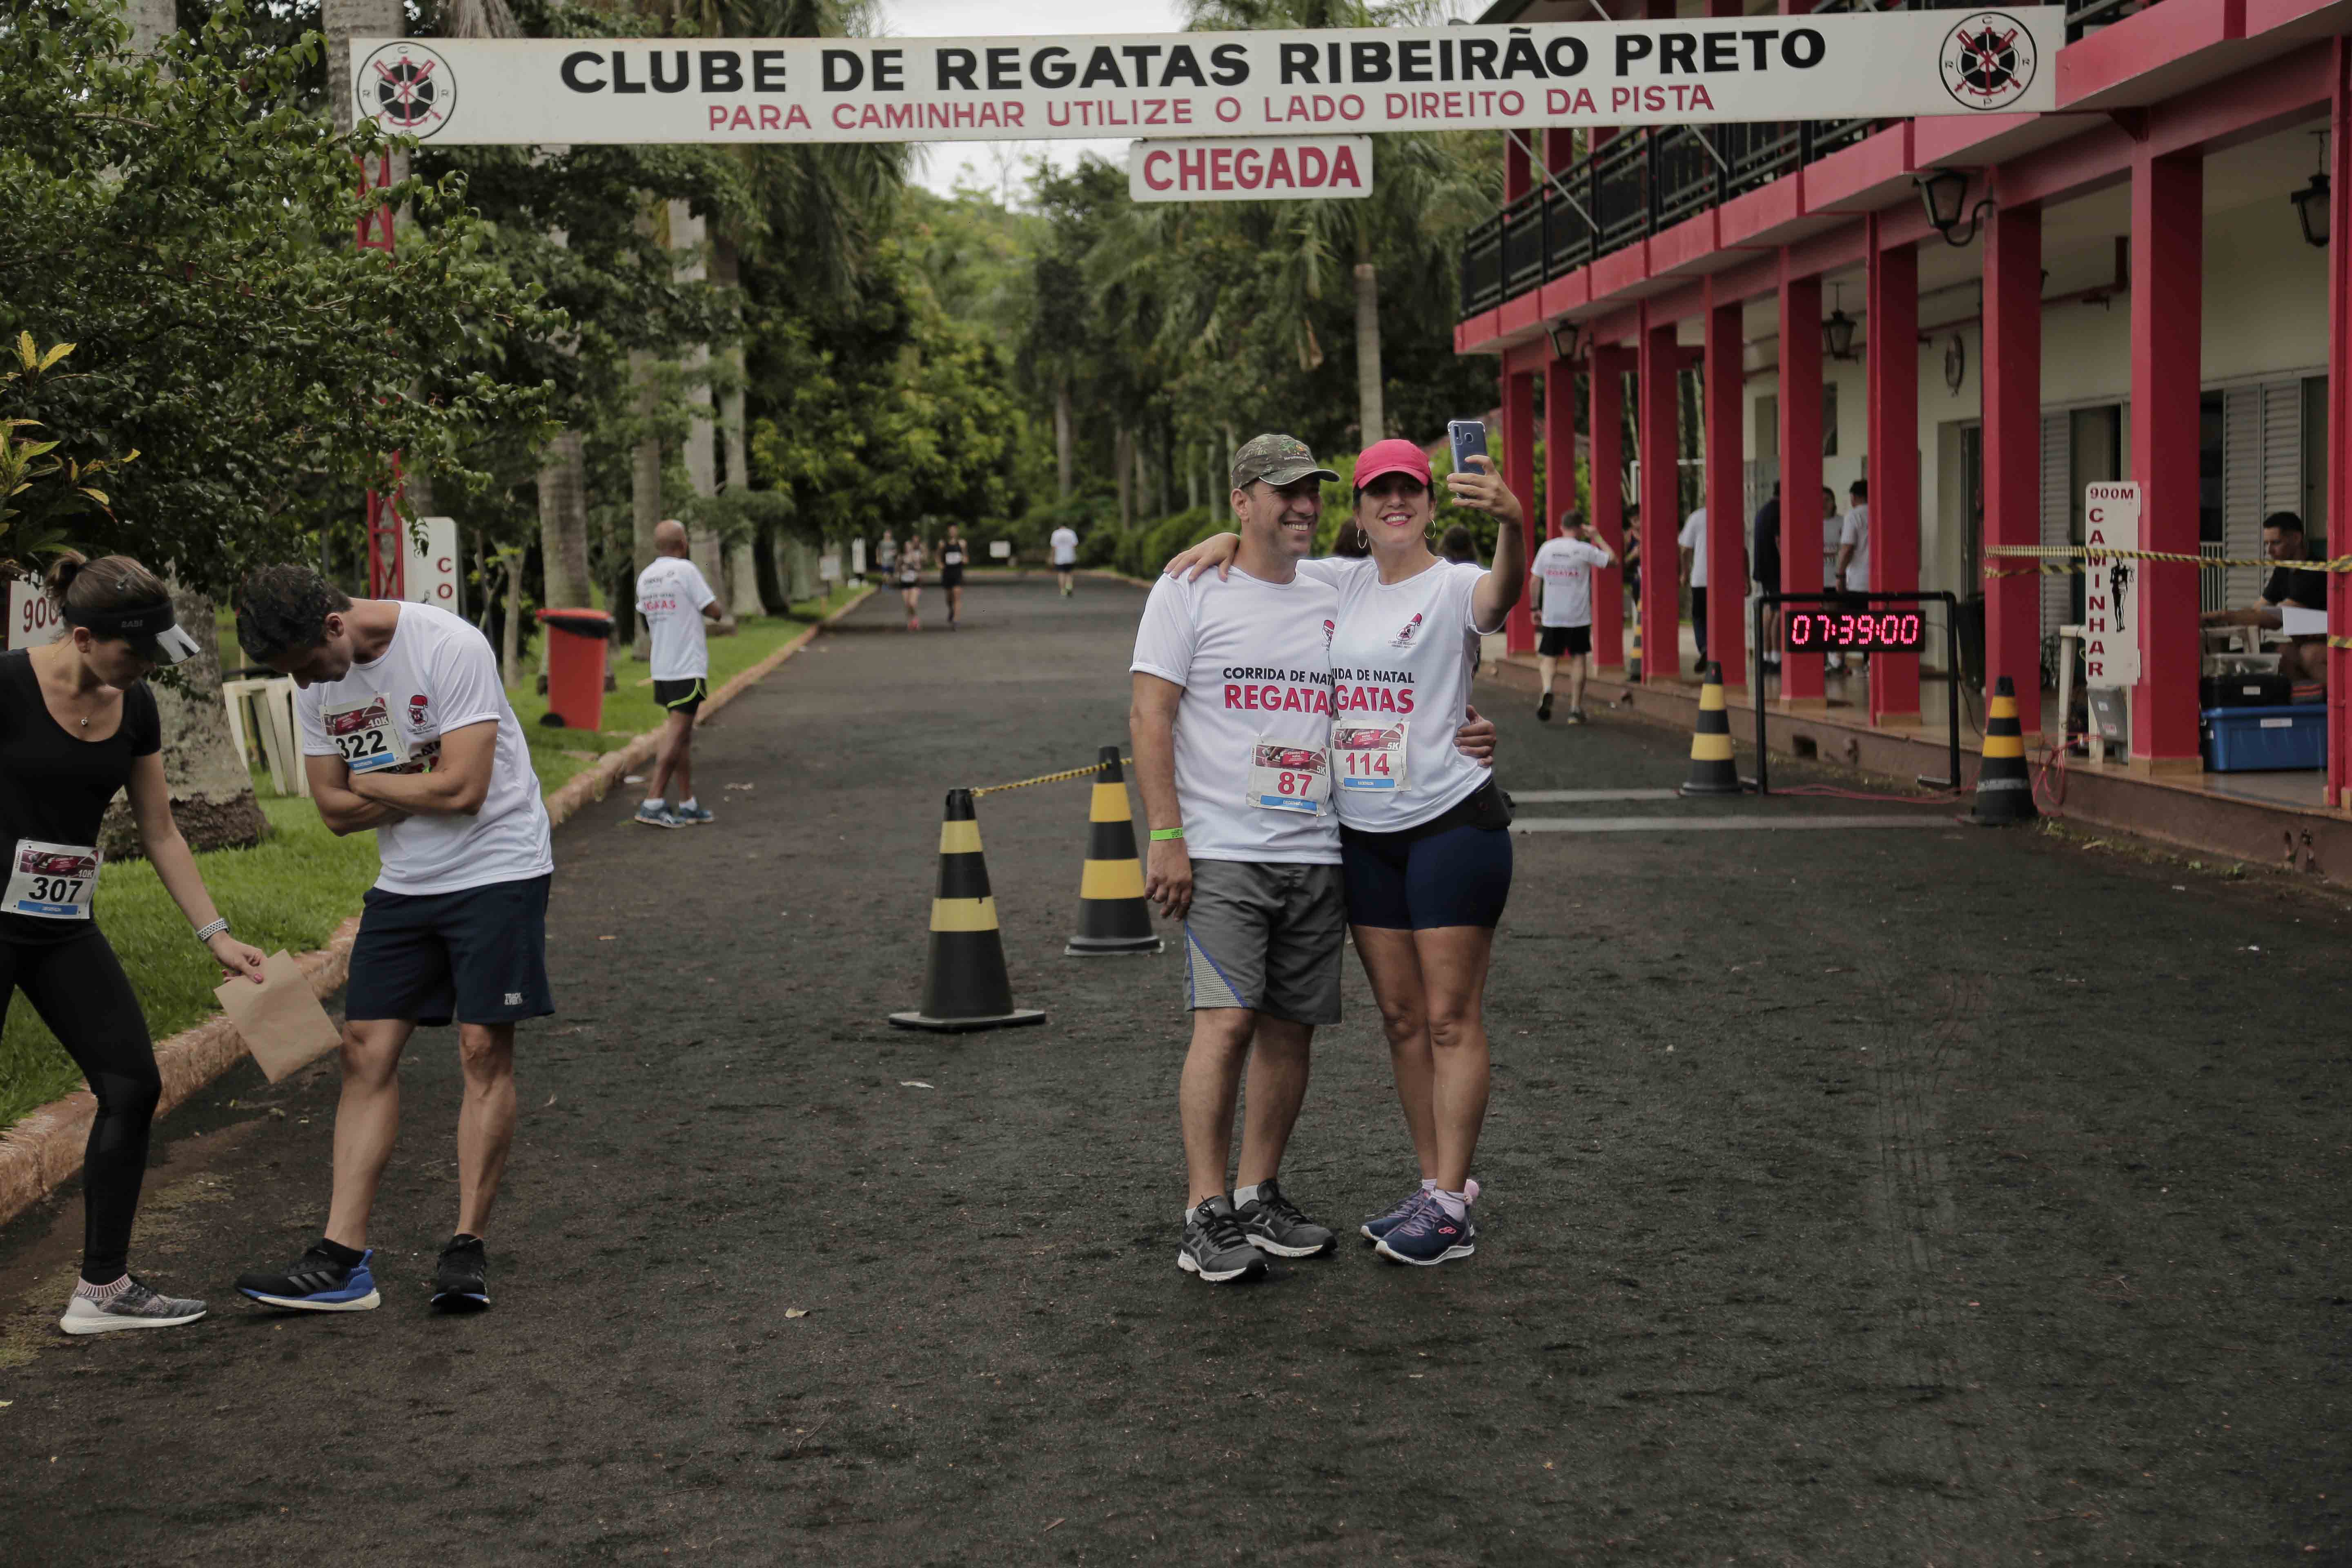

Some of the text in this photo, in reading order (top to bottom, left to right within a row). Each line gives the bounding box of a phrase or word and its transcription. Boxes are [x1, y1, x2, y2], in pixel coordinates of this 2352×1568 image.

[561, 28, 1826, 94] CLUBE DE REGATAS RIBEIRÃO PRETO
[710, 85, 1713, 131] PARA CAMINHAR UTILIZE O LADO DIREITO DA PISTA
[1145, 146, 1362, 191] CHEGADA
[437, 557, 453, 599] CO
[2089, 508, 2108, 677] CAMINHAR
[1792, 615, 1918, 645] 07:39:00
[1223, 667, 1335, 688] CORRIDA DE NATA
[1332, 668, 1415, 684] IDA DE NATAL
[1335, 685, 1414, 714] GATAS
[369, 717, 388, 727] 10K
[336, 730, 388, 760] 322
[1316, 766, 1326, 775] 5K
[1346, 753, 1390, 775] 114
[1278, 772, 1312, 797] 87
[78, 869, 94, 878] 10K
[28, 877, 83, 902] 307
